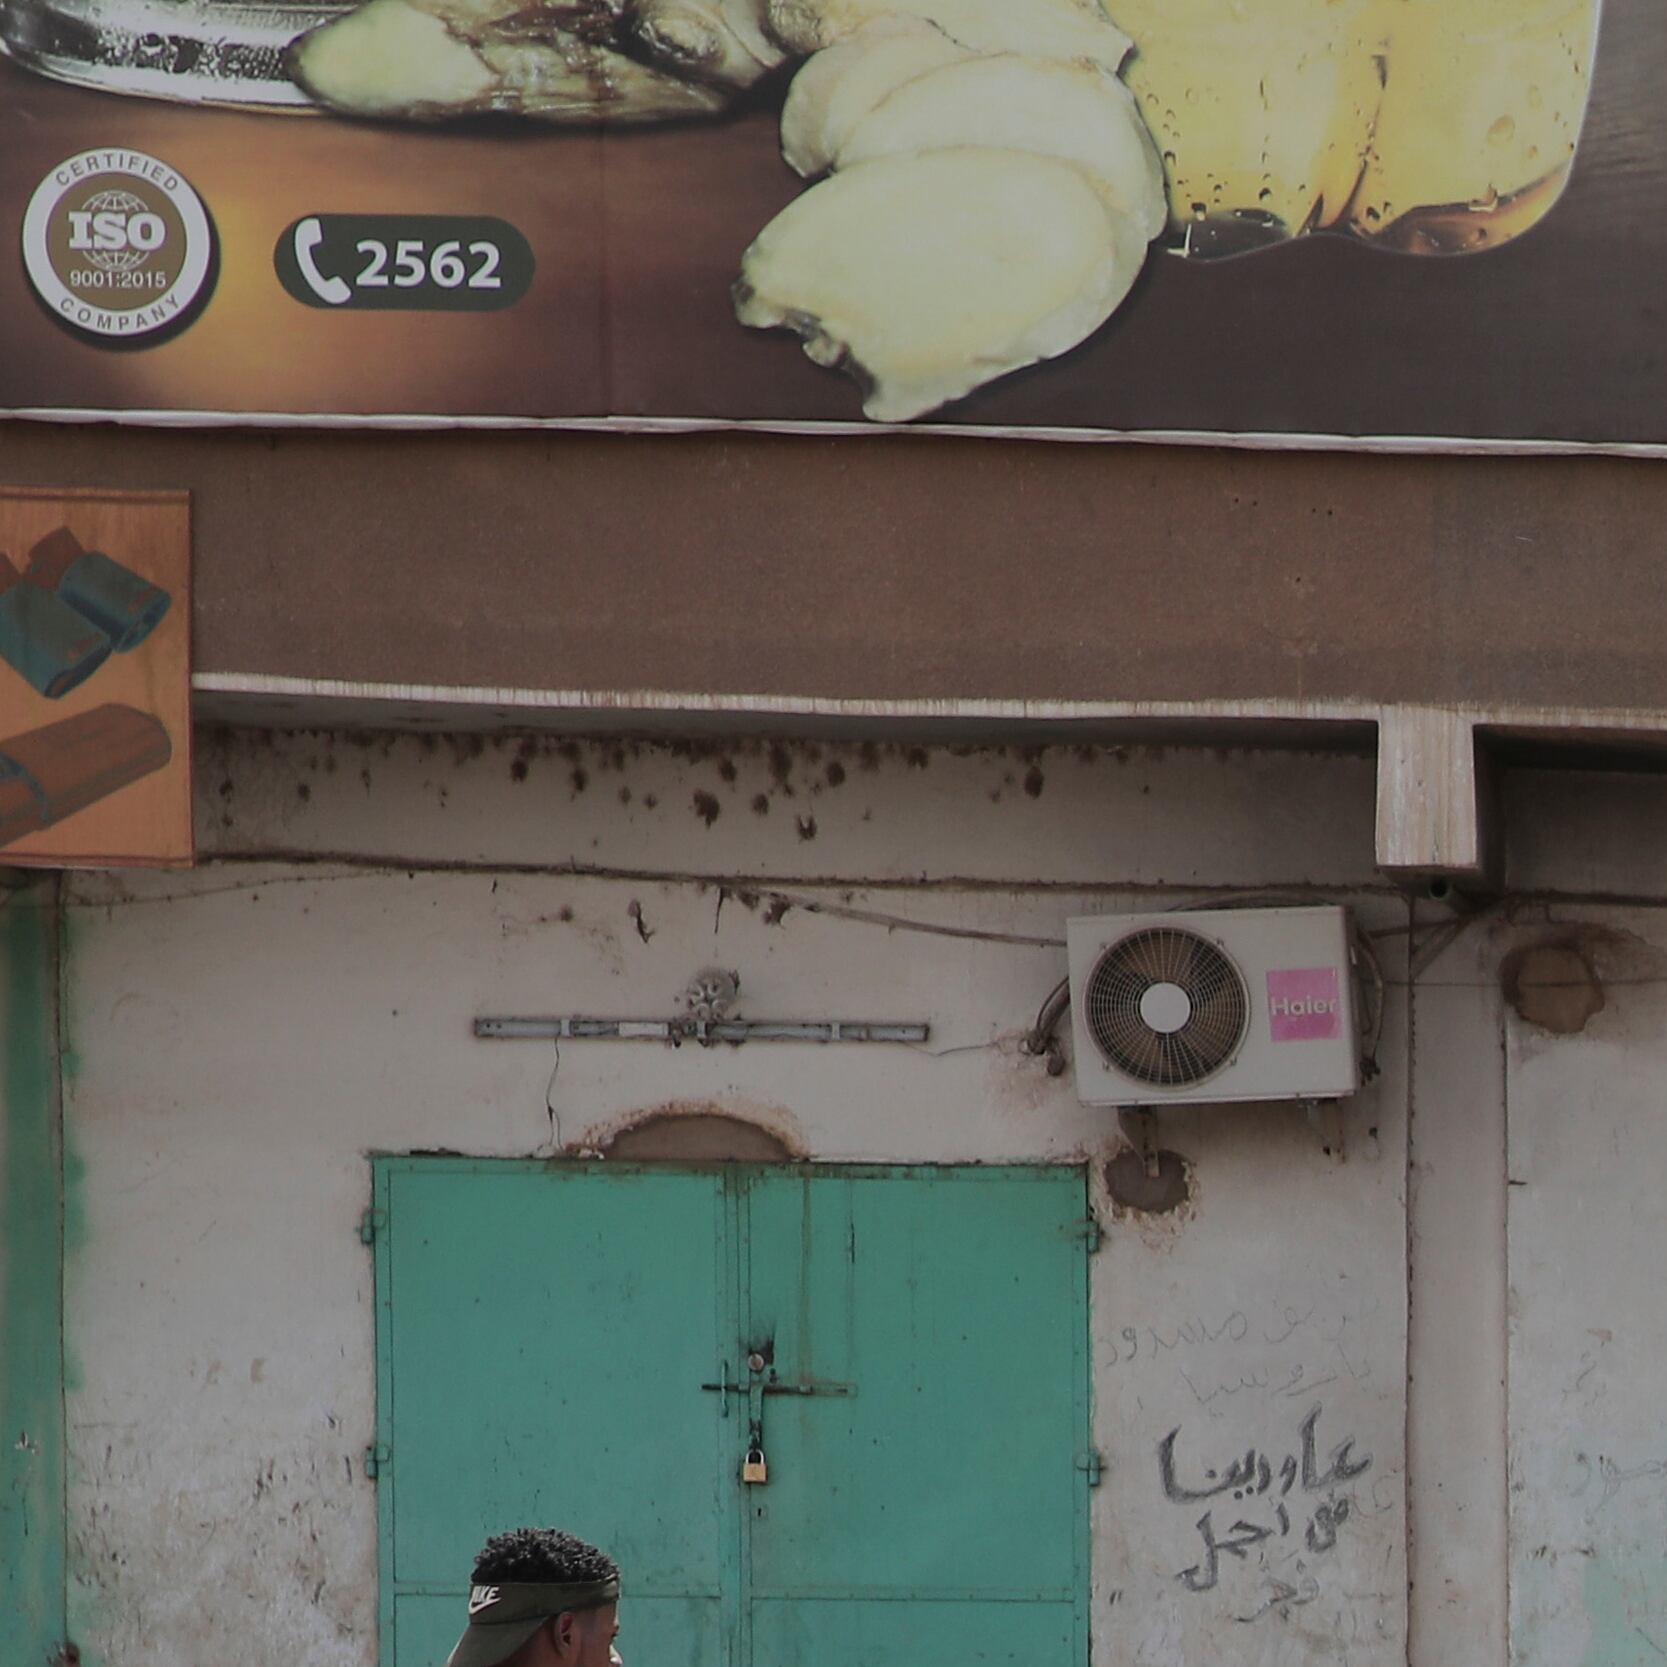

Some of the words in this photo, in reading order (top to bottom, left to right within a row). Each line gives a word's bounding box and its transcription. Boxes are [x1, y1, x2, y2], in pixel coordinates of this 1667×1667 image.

[56, 153, 178, 191] CERTIFIED
[68, 211, 166, 250] ISO
[70, 269, 166, 288] 9001:2015
[356, 239, 502, 289] 2562
[60, 294, 180, 330] COMPANY
[1270, 994, 1337, 1017] Haier
